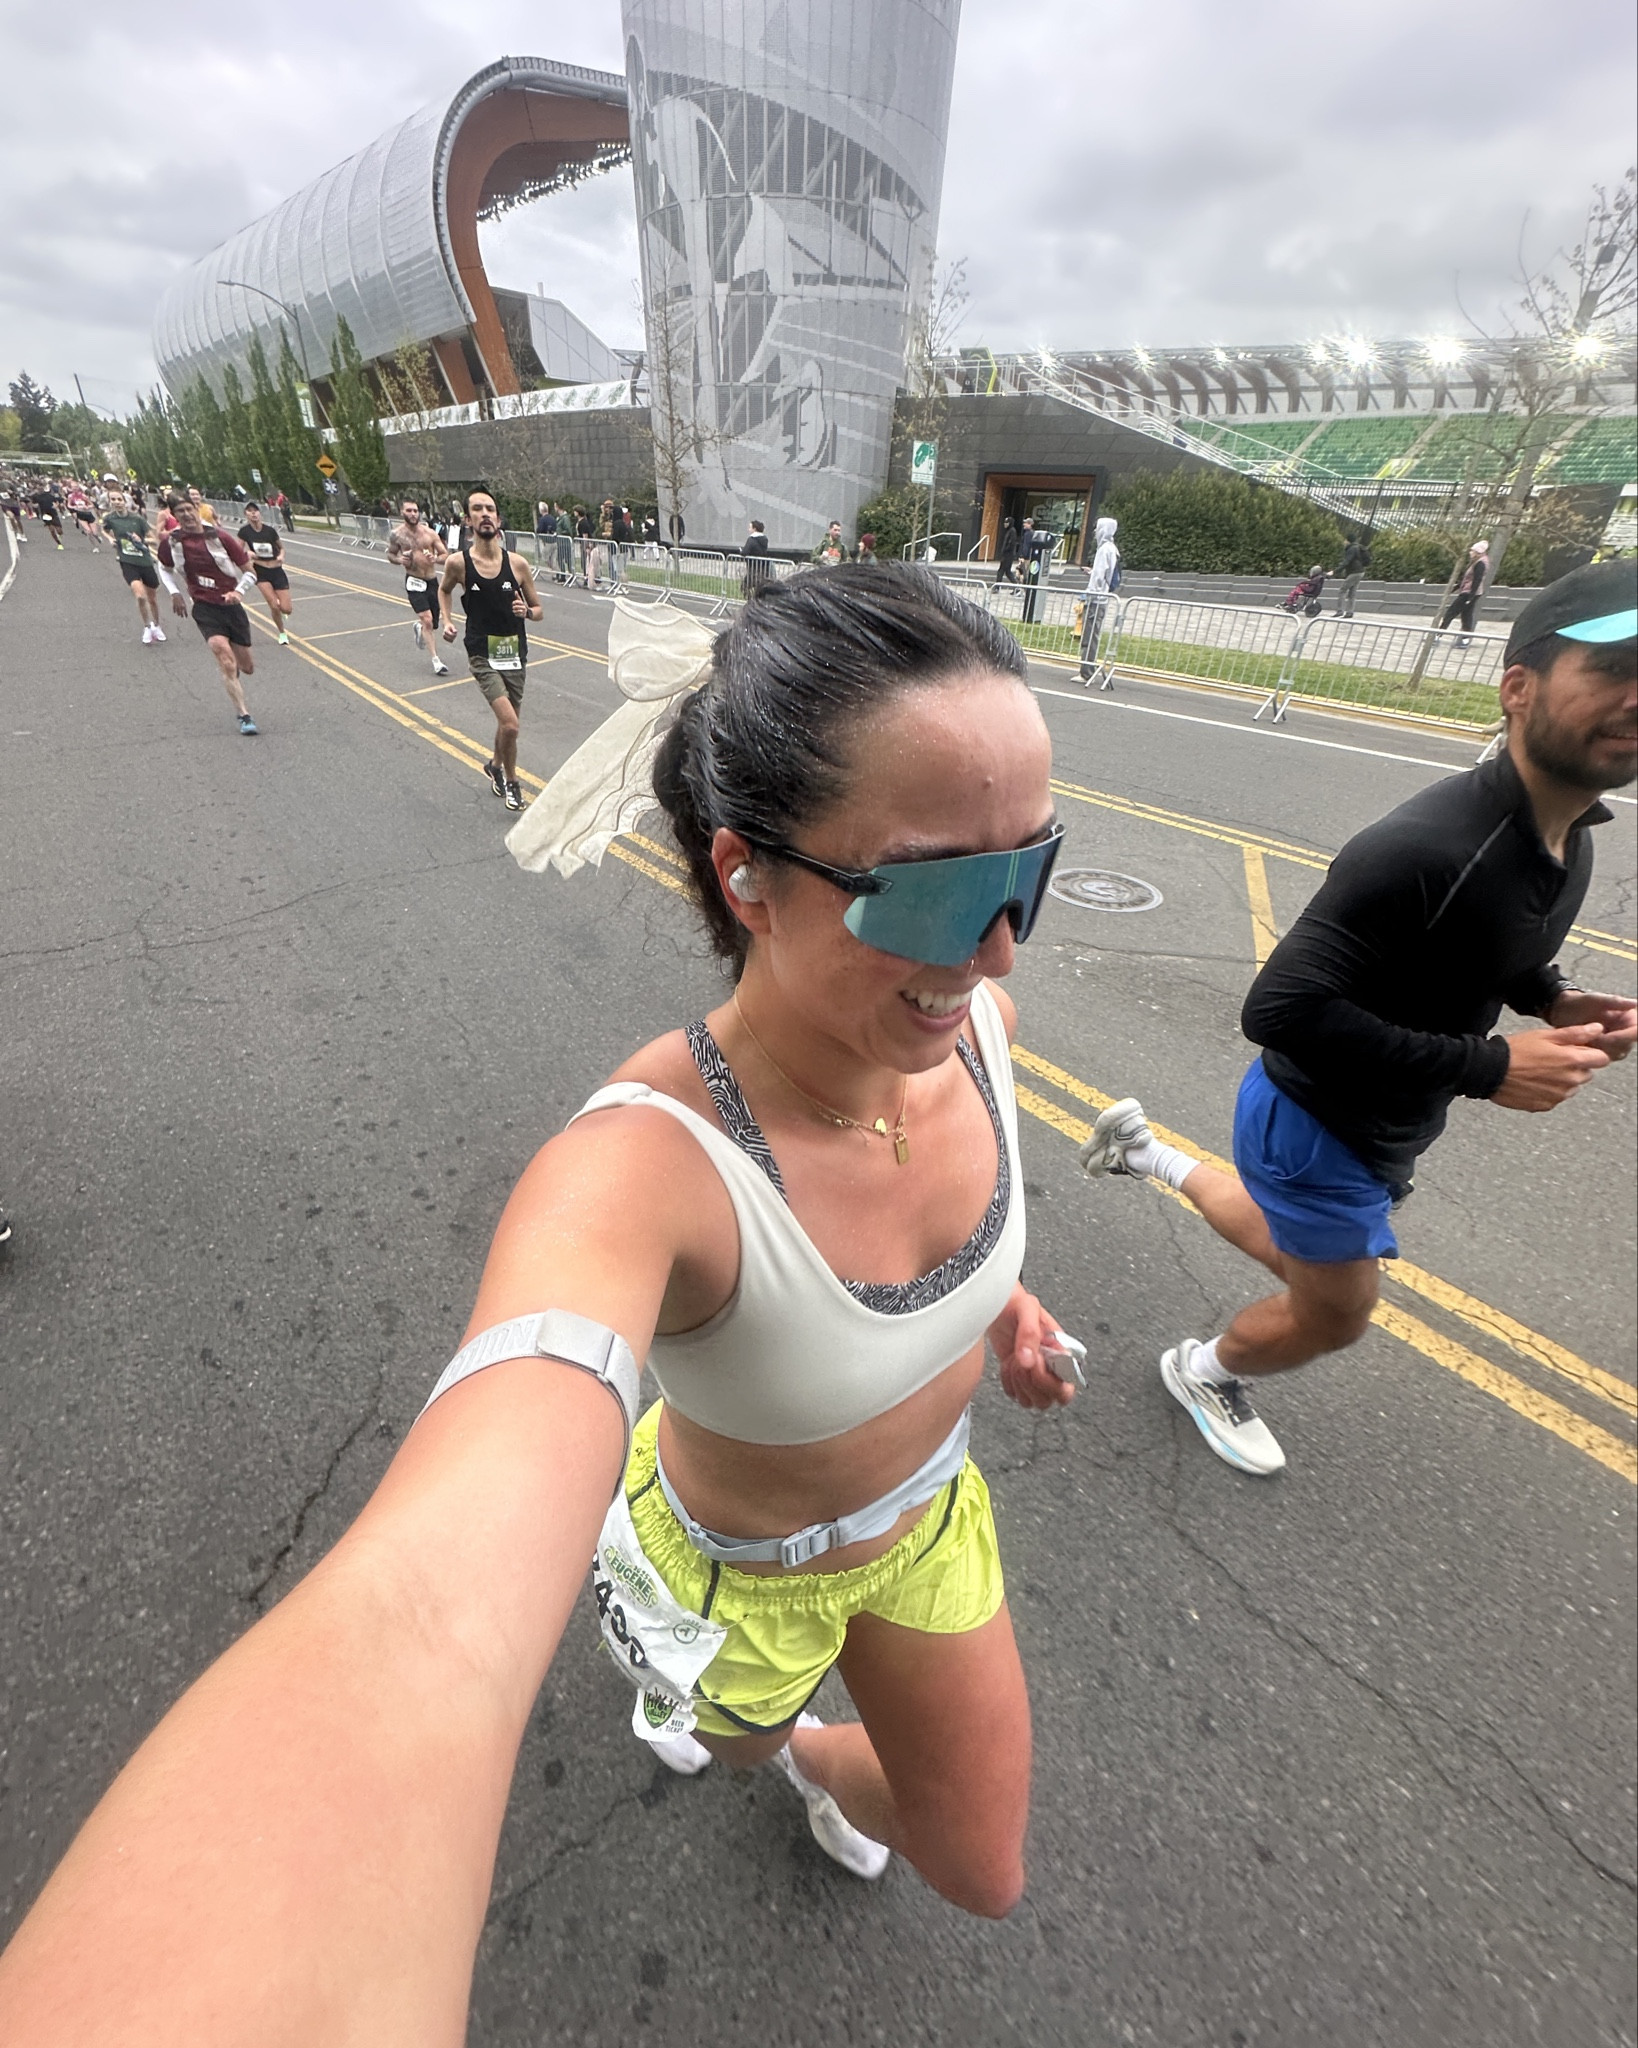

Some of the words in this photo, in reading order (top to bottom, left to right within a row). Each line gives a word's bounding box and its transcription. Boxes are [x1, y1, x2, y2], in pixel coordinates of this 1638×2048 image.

[496, 645, 513, 655] 3811
[610, 1556, 653, 1597] EUGENE
[671, 1719, 684, 1728] BEER
[666, 1725, 683, 1733] TICKET
